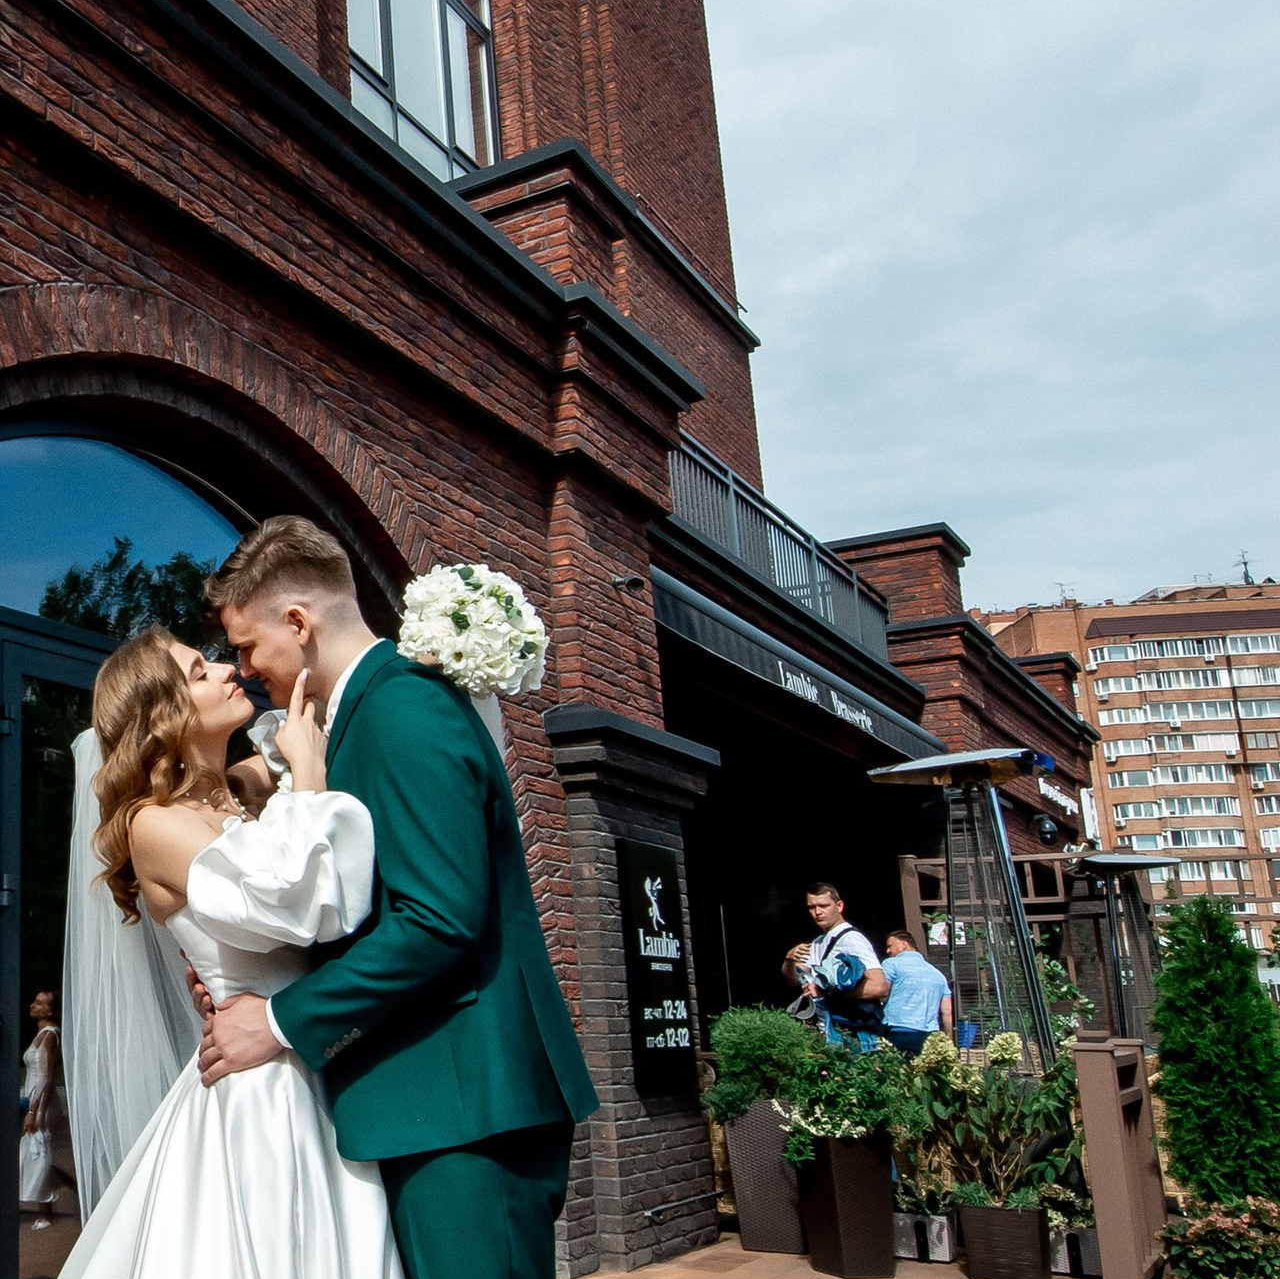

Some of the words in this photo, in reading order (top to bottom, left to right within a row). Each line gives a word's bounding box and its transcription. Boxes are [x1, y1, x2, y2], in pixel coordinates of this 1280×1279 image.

[777, 660, 819, 702] Lambic
[638, 928, 681, 959] Lambic
[663, 999, 688, 1020] 12-24
[666, 1027, 691, 1048] 12-02
